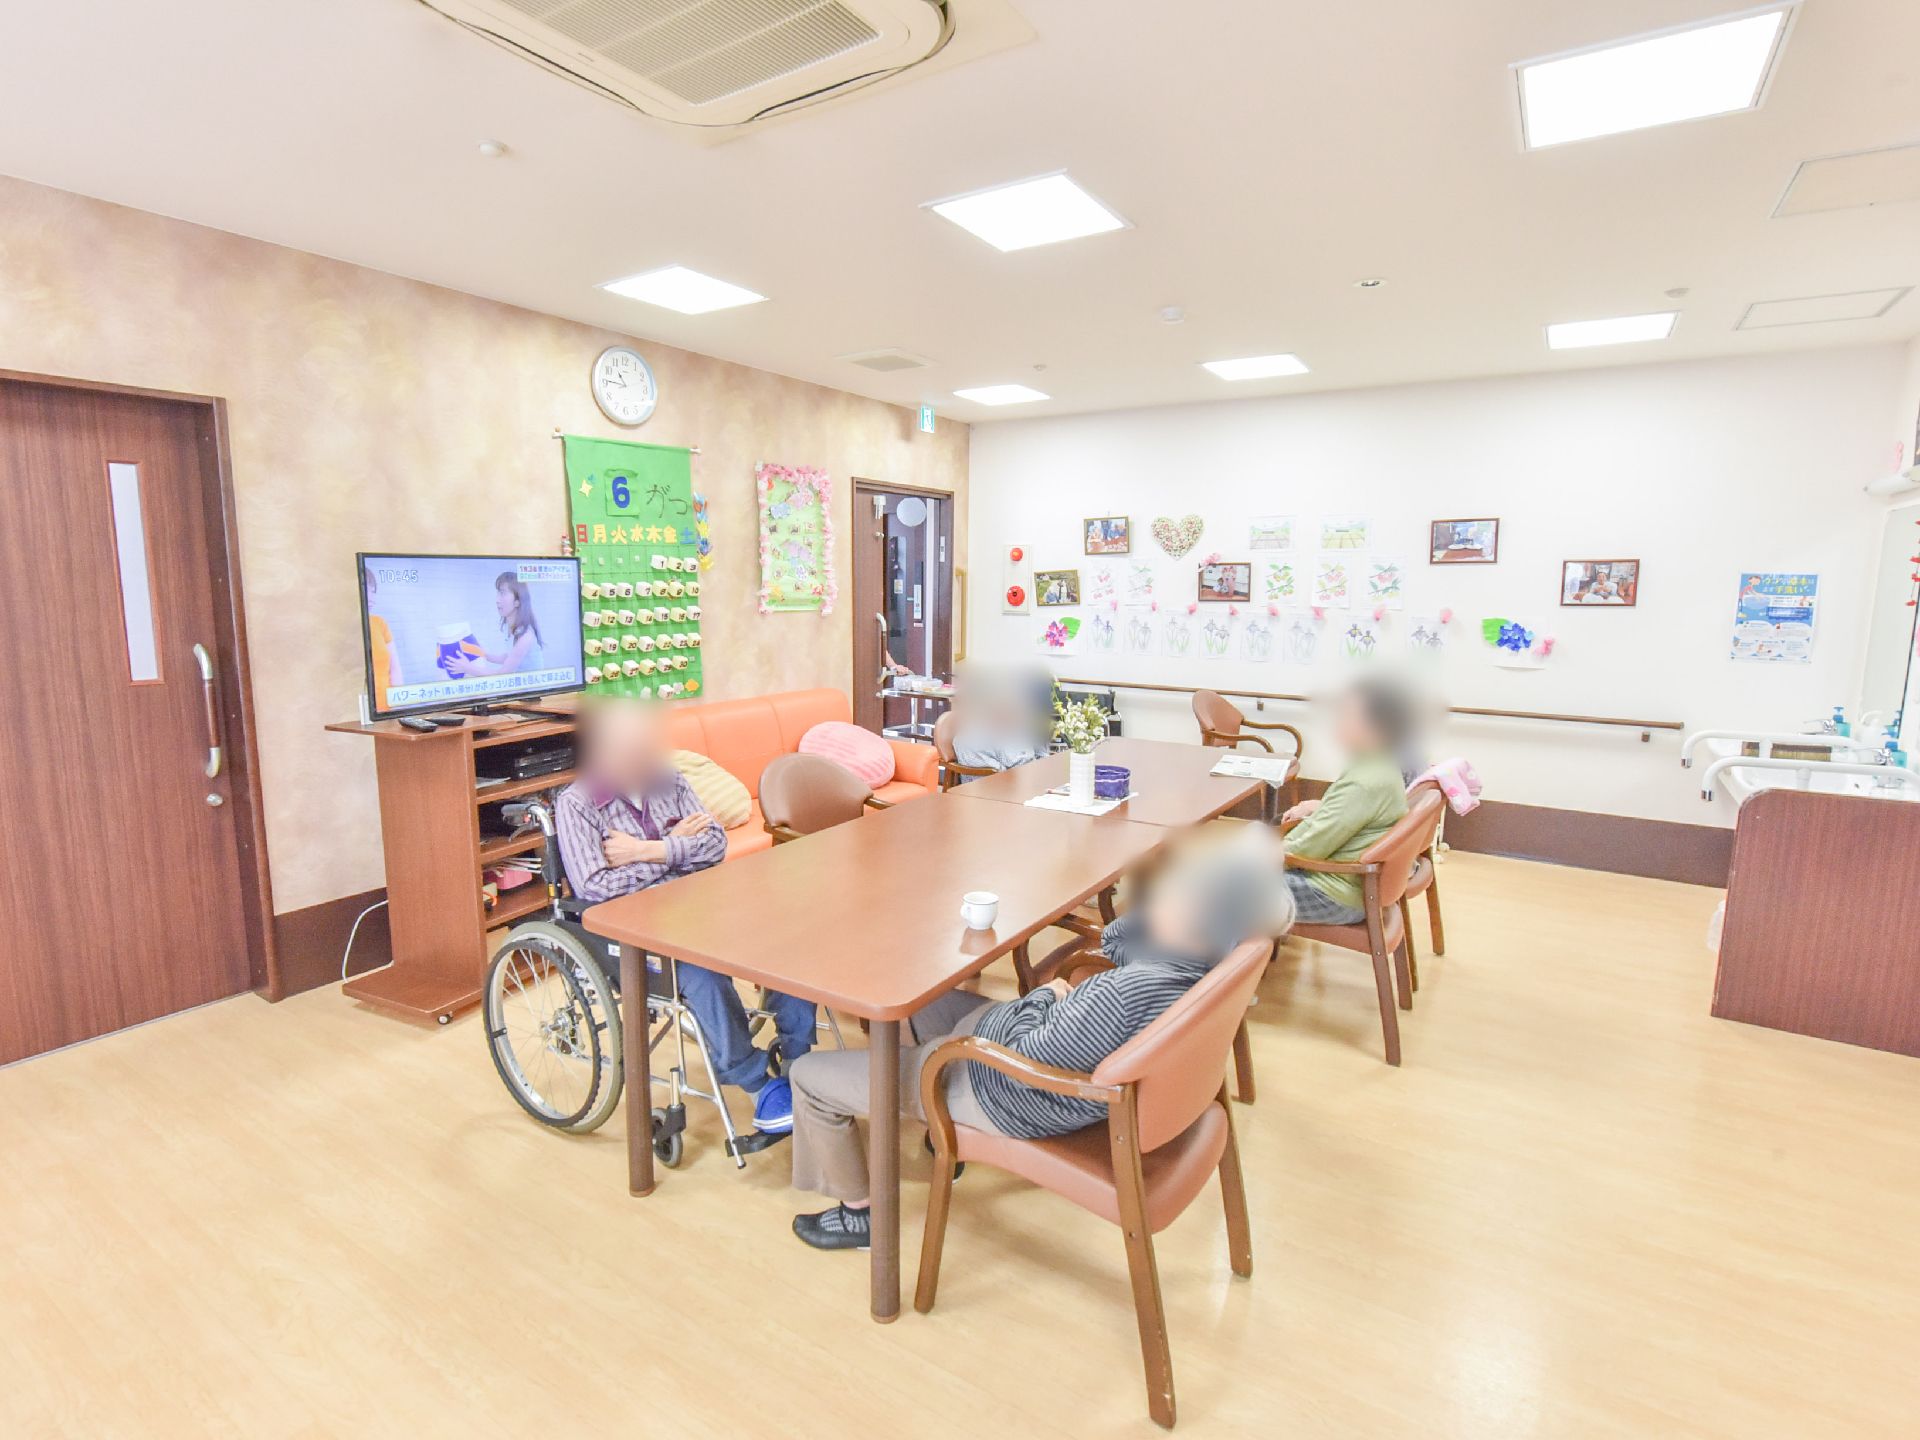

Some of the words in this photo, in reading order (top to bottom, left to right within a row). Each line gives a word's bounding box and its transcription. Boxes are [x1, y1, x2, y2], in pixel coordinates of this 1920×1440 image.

[612, 357, 619, 368] 11
[621, 355, 629, 367] 12
[605, 366, 613, 375] 10
[639, 371, 645, 382] 2
[602, 378, 609, 388] 9
[642, 385, 648, 395] 3
[606, 391, 613, 401] 8
[622, 406, 630, 416] 6
[611, 475, 631, 509] 6
[645, 483, 688, 519] がつ
[379, 569, 419, 583] 10:45
